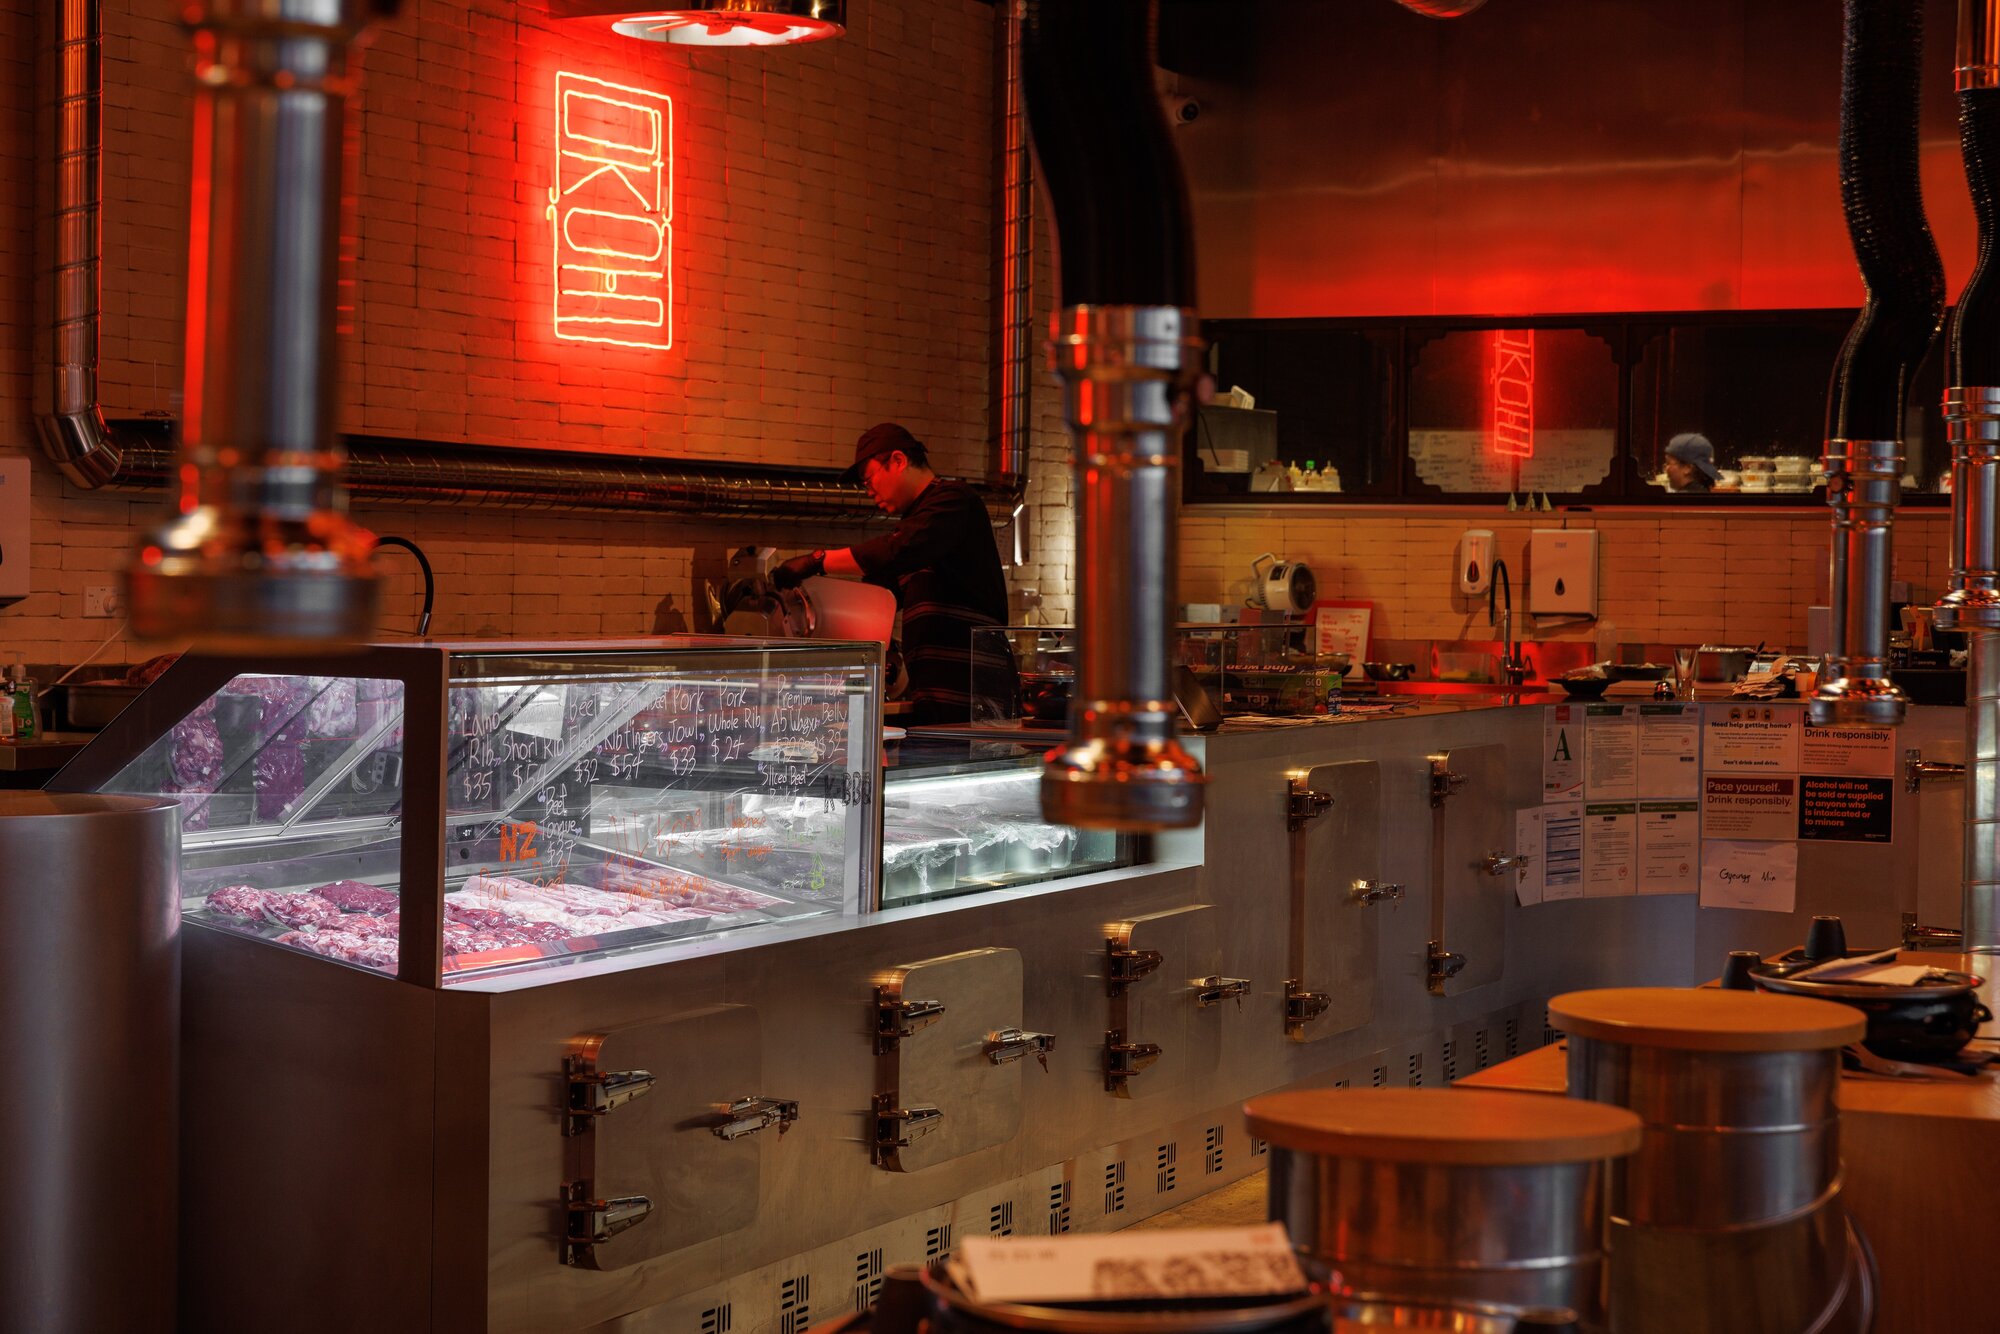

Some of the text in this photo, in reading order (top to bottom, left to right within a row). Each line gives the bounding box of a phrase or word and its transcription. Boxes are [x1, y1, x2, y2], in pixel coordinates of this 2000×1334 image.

[673, 676, 705, 713] Pork
[717, 675, 747, 711] Pork
[1804, 729, 1890, 742] Drink responsibly.
[1552, 728, 1572, 761] A
[610, 753, 644, 780] $54
[669, 744, 698, 777] $33
[463, 771, 493, 803] $35
[1707, 781, 1781, 793] Pace yourself.
[1805, 781, 1838, 789] Alcohol
[1707, 795, 1792, 807] Drink responsibly.
[1805, 790, 1816, 798] be
[1817, 791, 1835, 799] sold
[1847, 792, 1884, 801] supplied
[1815, 801, 1847, 809] anyone
[1804, 808, 1812, 816] is
[1813, 809, 1861, 818] intoxicated
[1815, 818, 1845, 826] minors
[499, 820, 537, 862] NZ
